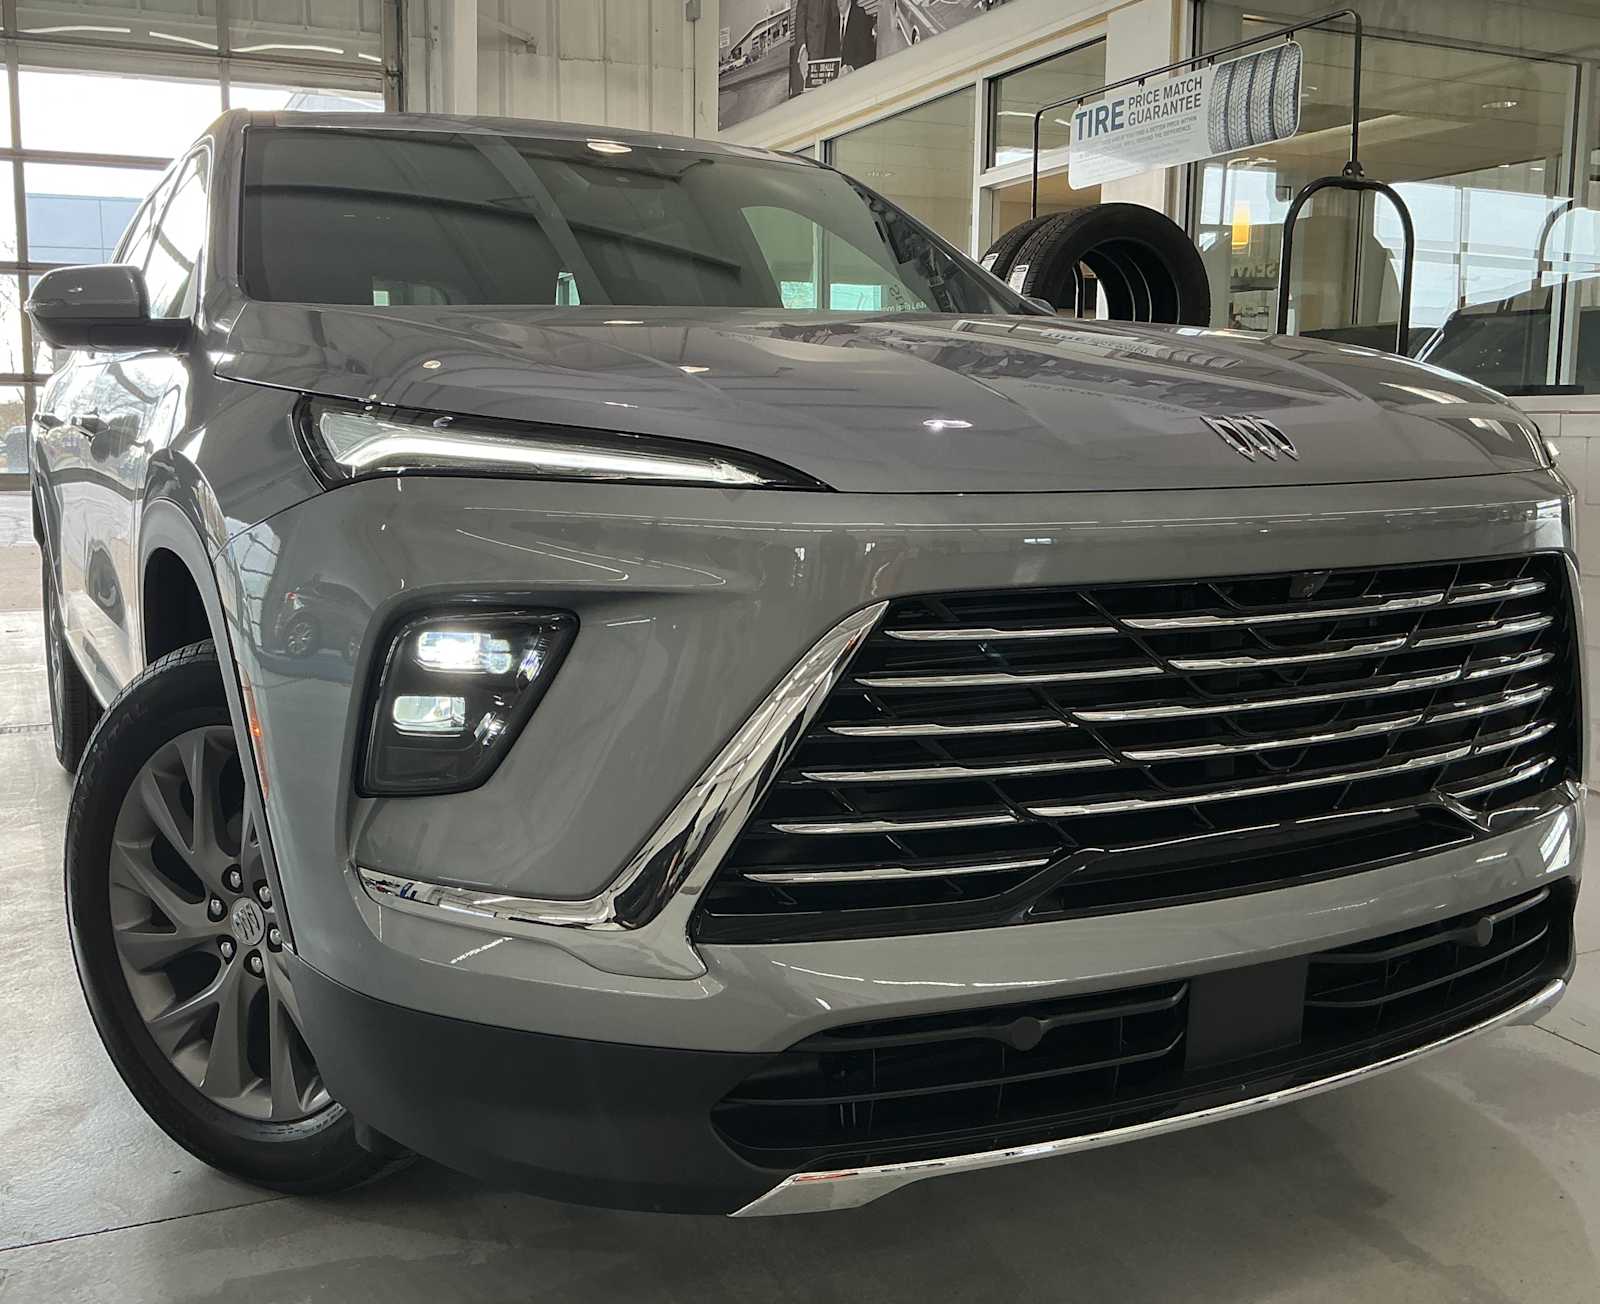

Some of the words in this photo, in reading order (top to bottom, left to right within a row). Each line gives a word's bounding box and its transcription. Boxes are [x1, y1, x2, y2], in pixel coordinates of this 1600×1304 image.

[1128, 89, 1160, 110] PRICE
[1163, 77, 1202, 99] MATCH
[1128, 93, 1201, 126] GUARANTEE
[1076, 100, 1124, 141] TIRE
